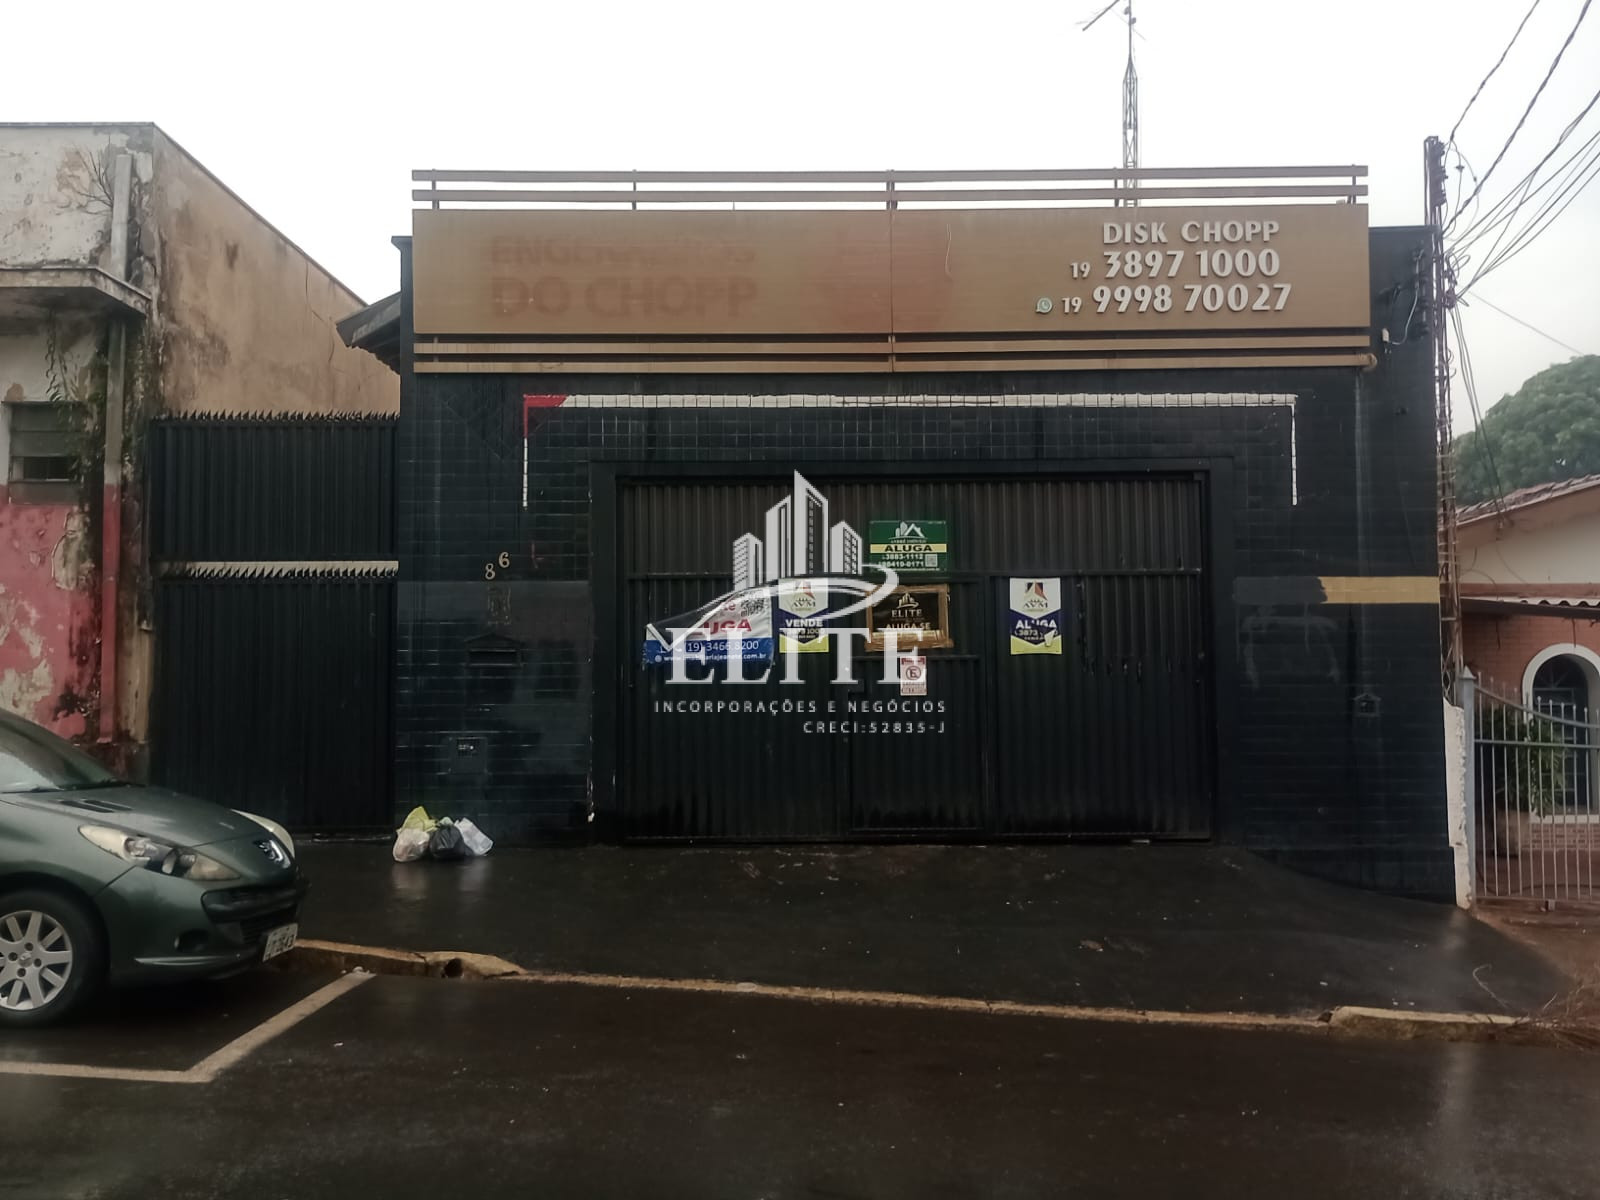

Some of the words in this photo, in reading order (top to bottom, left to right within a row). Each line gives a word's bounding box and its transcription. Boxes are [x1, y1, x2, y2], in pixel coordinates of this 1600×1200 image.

[1103, 222, 1169, 245] DISK
[1181, 220, 1280, 242] CHOPP
[1070, 262, 1091, 279] 19
[1103, 250, 1185, 279] 3897
[1195, 248, 1280, 277] 1000
[491, 275, 571, 318] DO
[584, 275, 758, 318] CHOPP
[1061, 297, 1082, 314] 19
[1093, 284, 1173, 314] 9998
[1184, 283, 1292, 312] 70027
[785, 618, 823, 628] VENDE
[891, 609, 922, 618] ELITE
